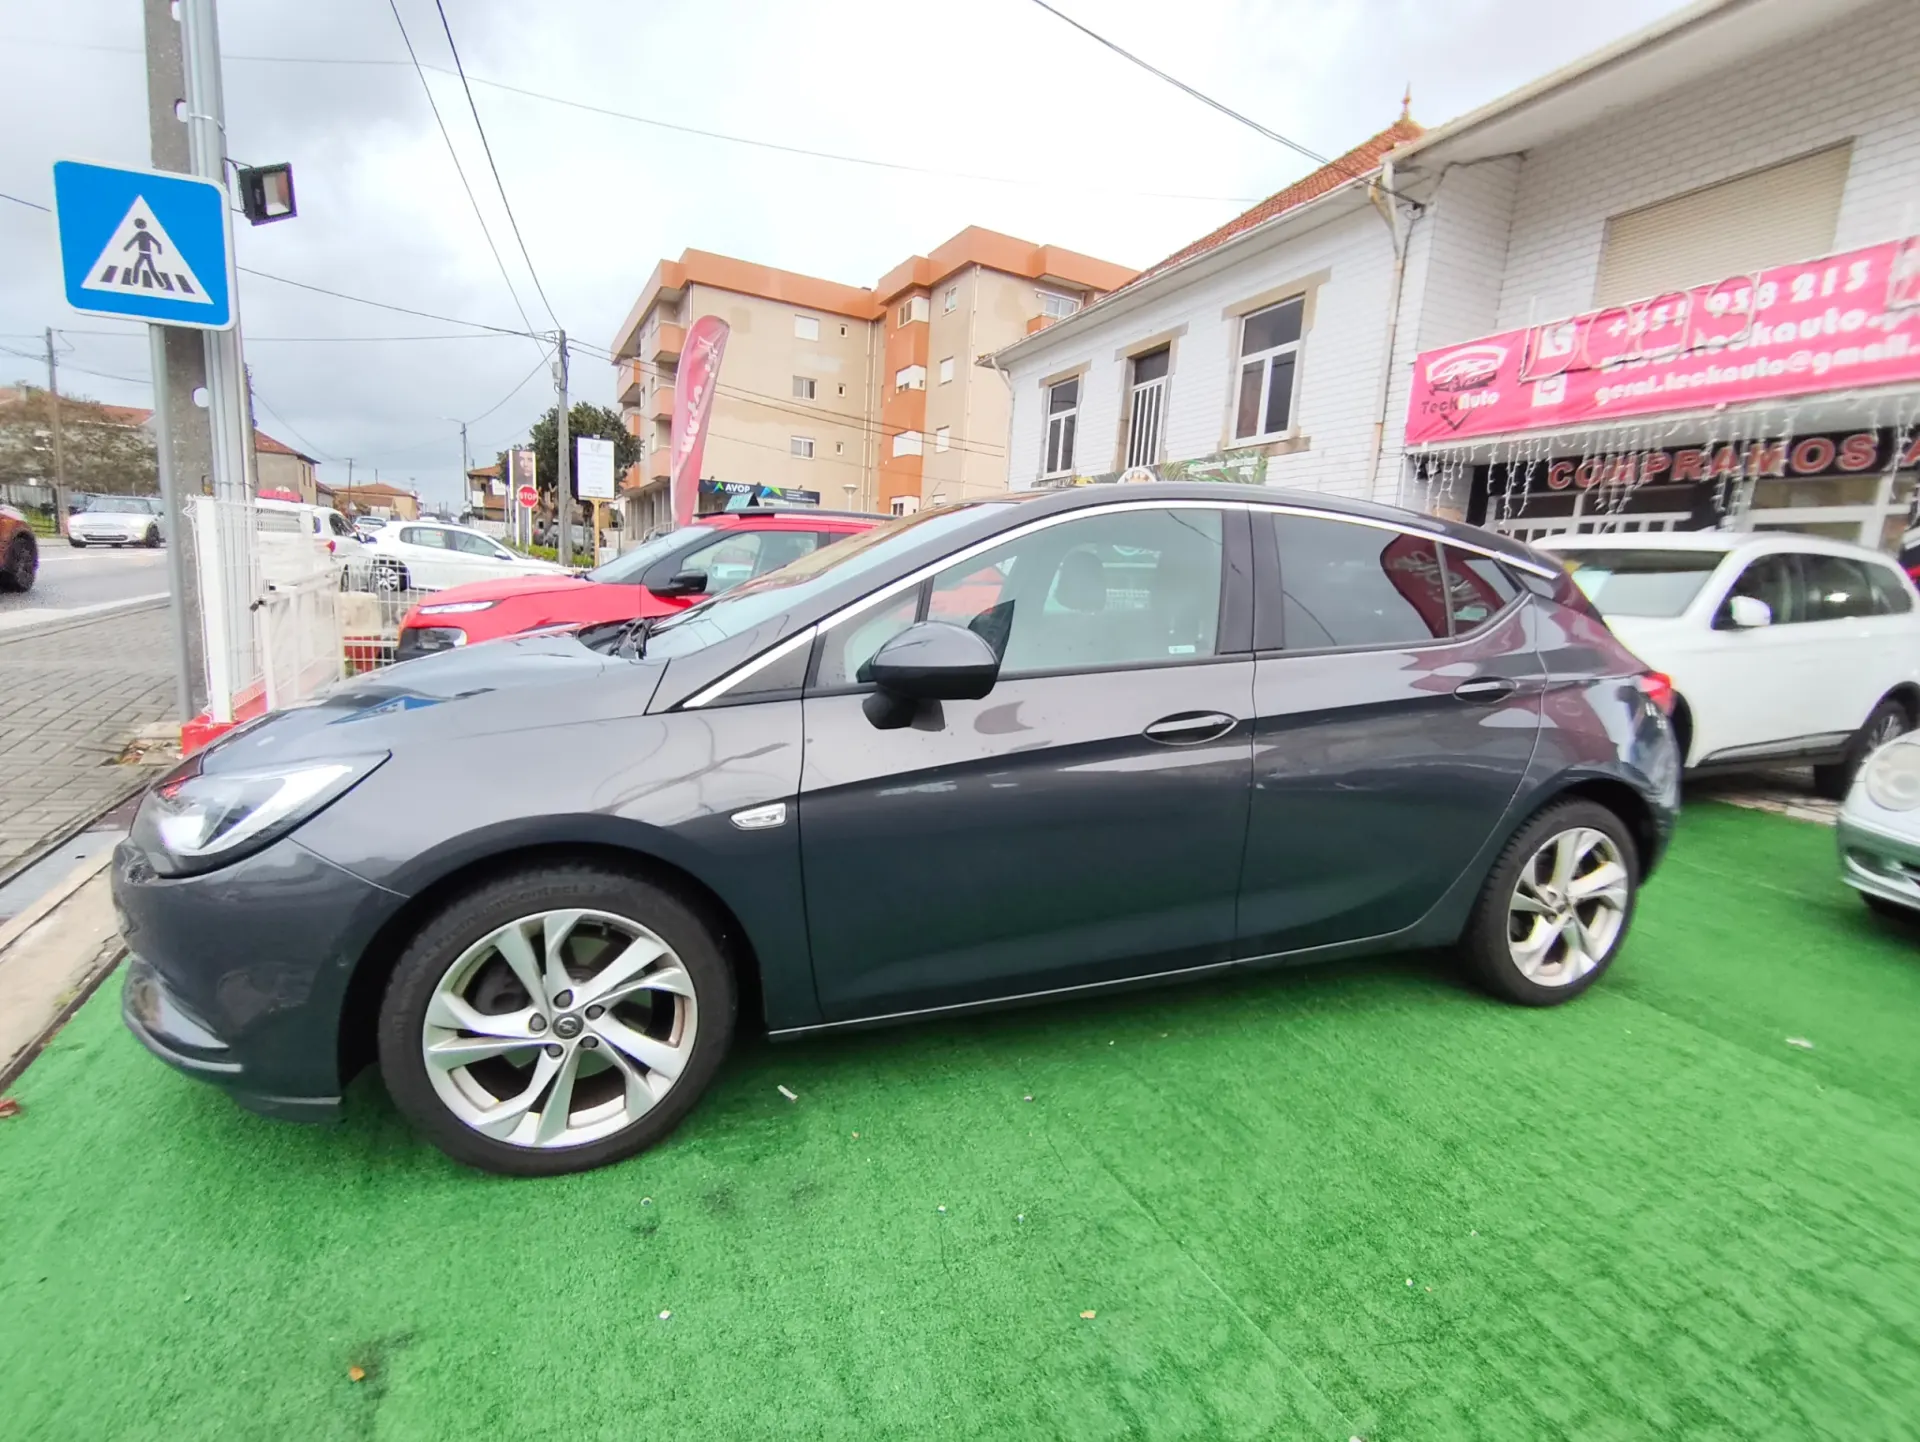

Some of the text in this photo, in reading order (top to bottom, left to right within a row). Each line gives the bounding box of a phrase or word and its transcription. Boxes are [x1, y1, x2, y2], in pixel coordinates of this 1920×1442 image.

[1547, 433, 1879, 490] COMPRAMOS
[725, 483, 751, 494] AVOP
[519, 491, 538, 501] STOP
